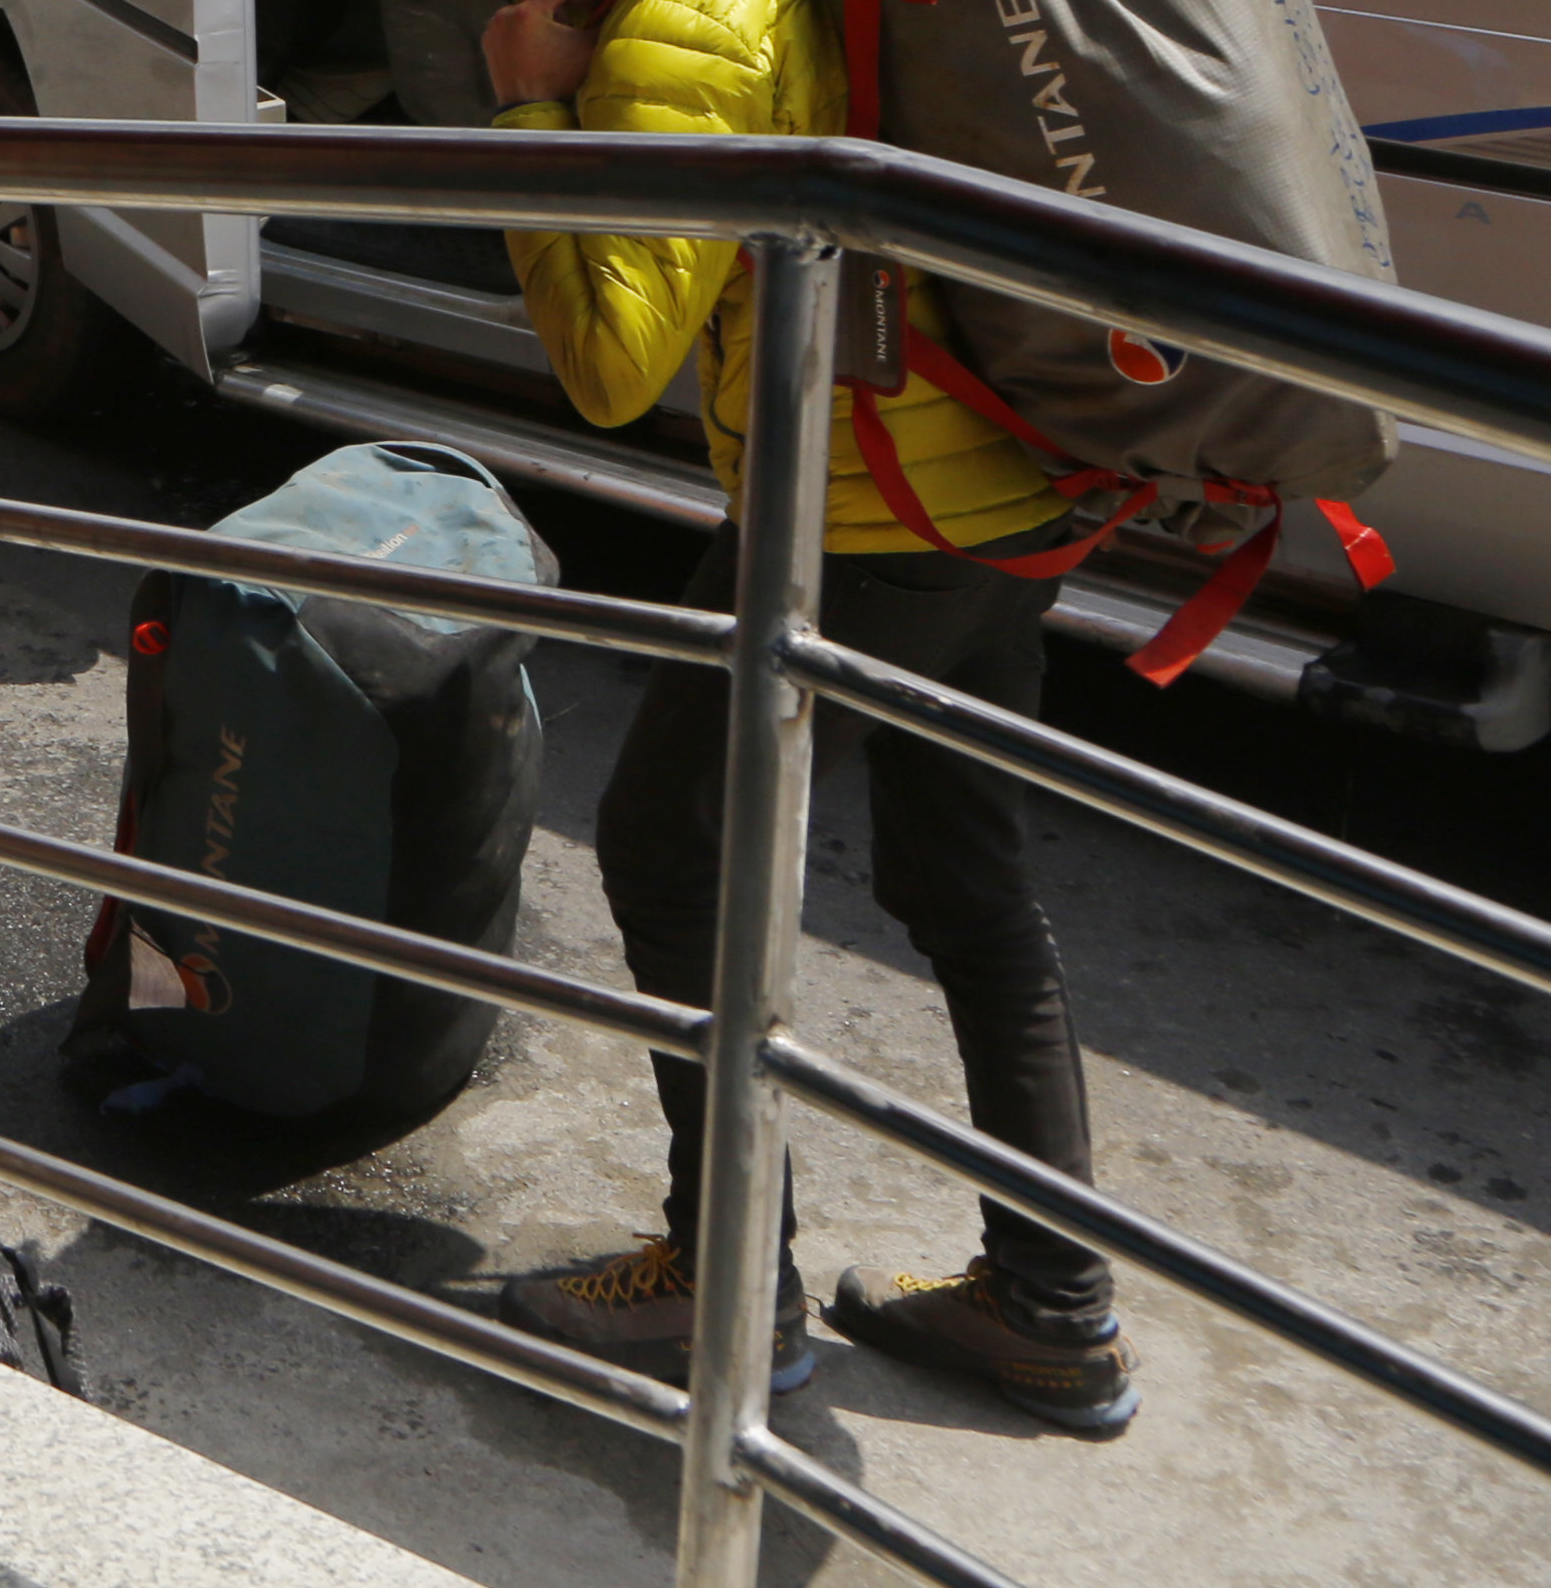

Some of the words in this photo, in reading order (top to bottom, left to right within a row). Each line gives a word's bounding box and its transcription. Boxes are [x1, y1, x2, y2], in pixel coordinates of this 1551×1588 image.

[996, 0, 1106, 199] NTANE
[875, 290, 888, 363] MONTANE
[195, 724, 248, 955] MNTANE
